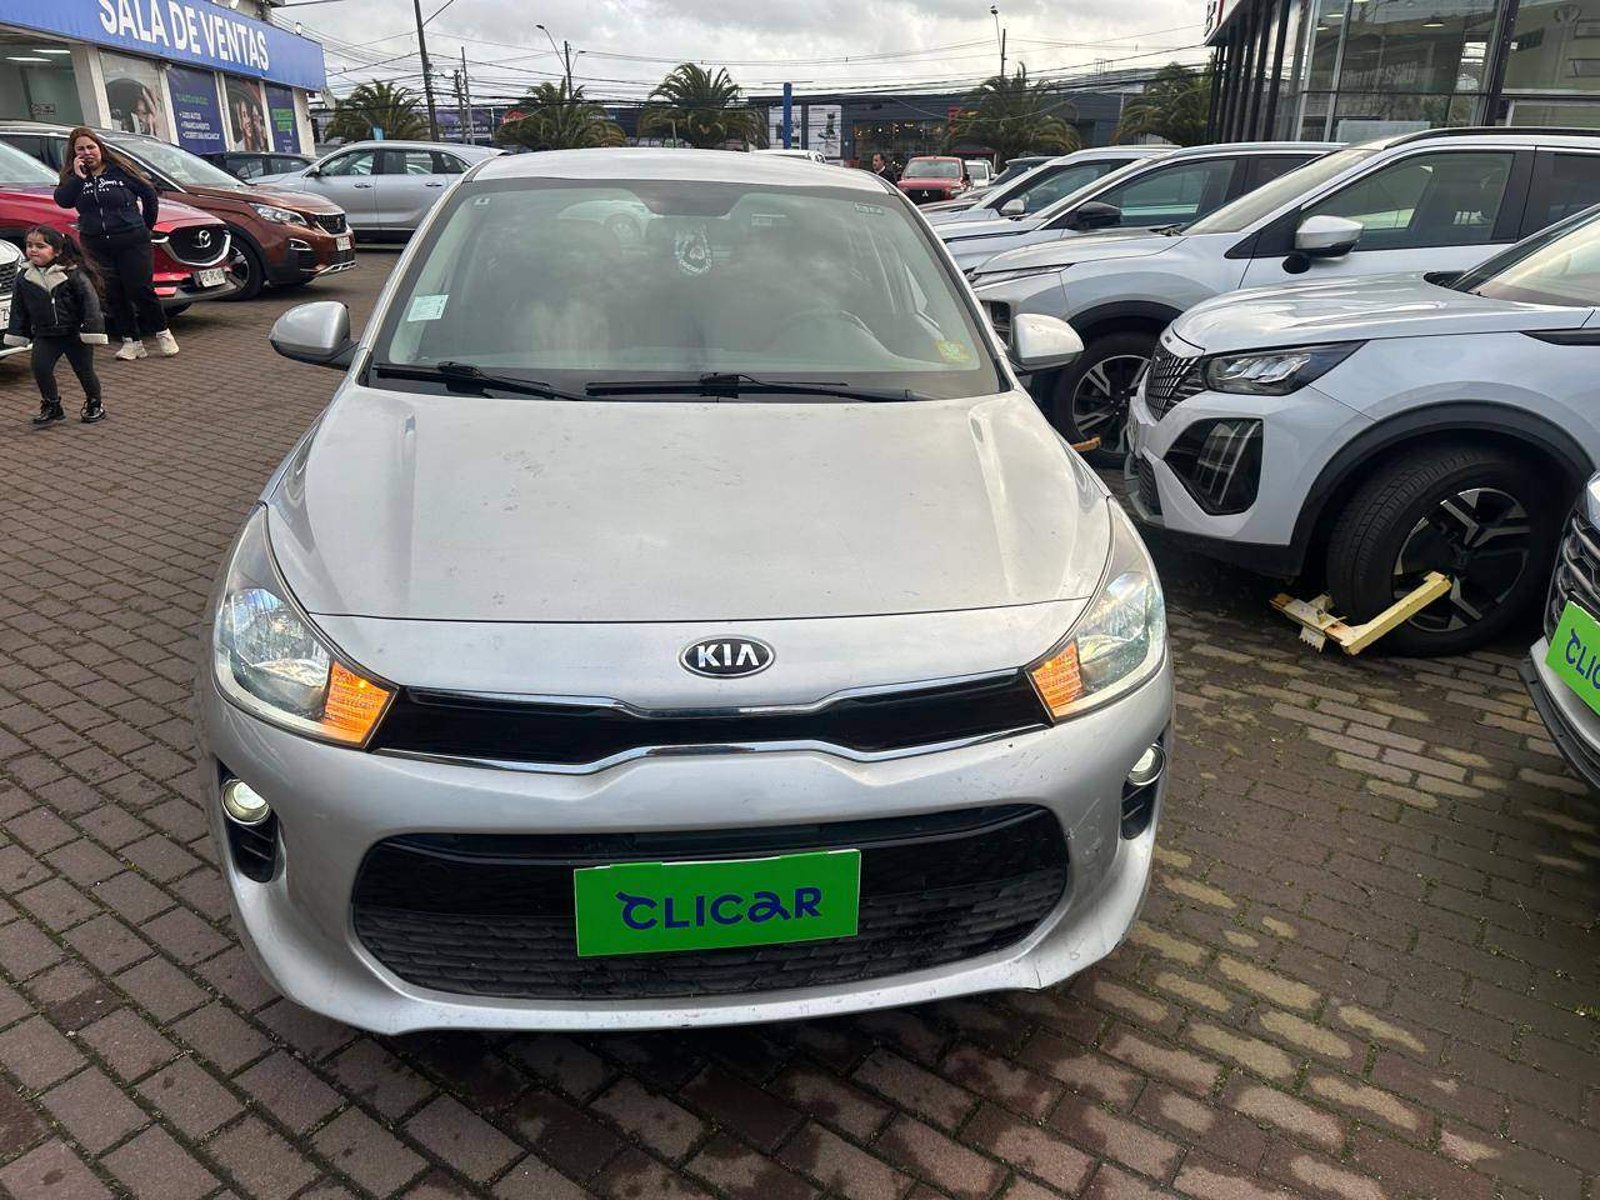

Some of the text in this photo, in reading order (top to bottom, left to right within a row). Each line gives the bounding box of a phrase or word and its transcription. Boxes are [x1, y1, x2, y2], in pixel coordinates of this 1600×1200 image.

[99, 0, 270, 72] SALA DE VENTAS
[696, 643, 760, 668] KIA
